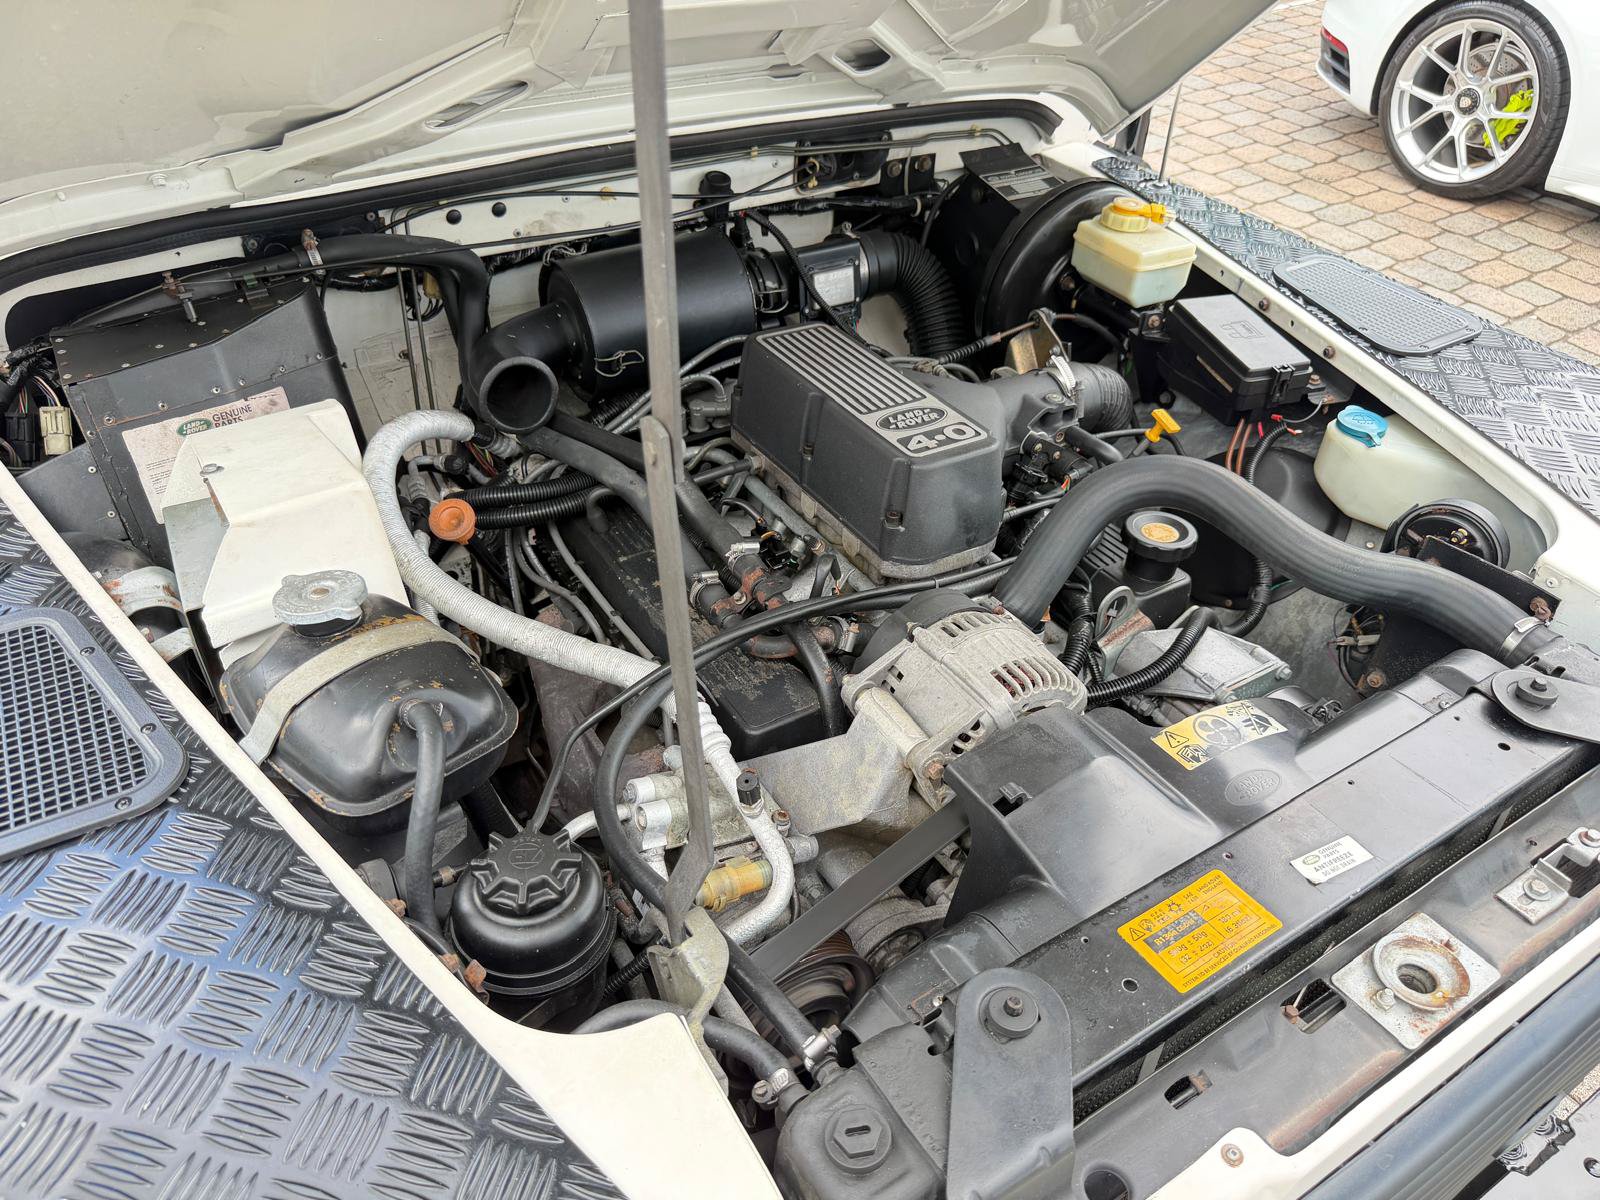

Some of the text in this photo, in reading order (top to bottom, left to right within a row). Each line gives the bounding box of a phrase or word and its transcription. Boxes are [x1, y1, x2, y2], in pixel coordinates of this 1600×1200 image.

[212, 404, 253, 422] GENUINE
[1314, 851, 1354, 872] ANTIFREEZE
[1213, 941, 1237, 959] CAUTION
